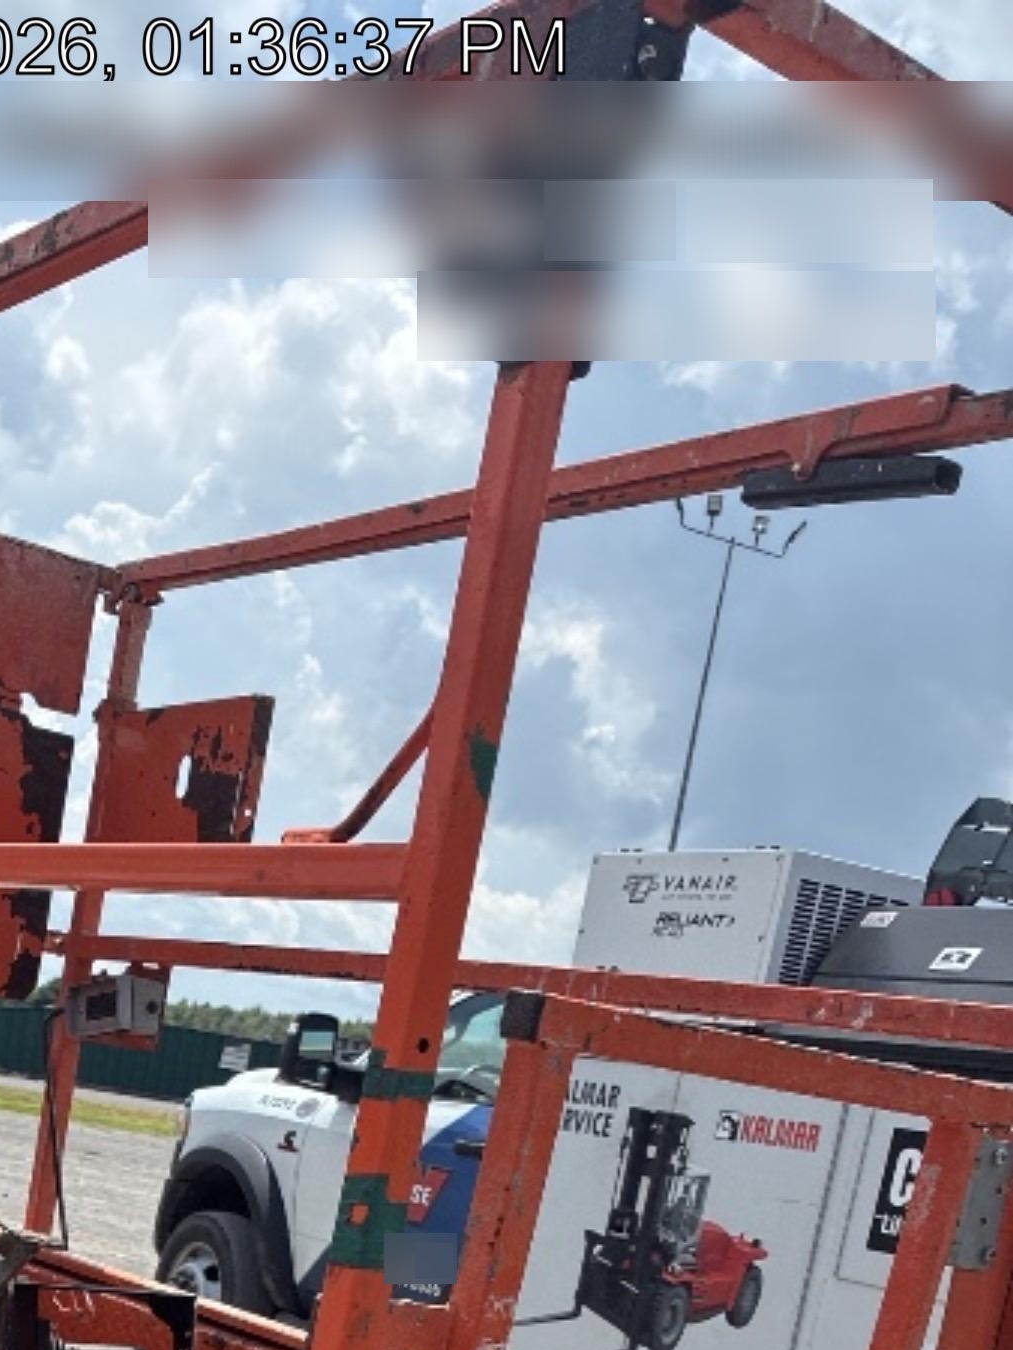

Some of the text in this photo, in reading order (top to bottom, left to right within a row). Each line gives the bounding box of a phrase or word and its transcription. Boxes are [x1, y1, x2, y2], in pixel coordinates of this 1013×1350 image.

[664, 875, 737, 891] VANAIR
[565, 1080, 622, 1110] LMAR
[740, 1115, 822, 1152] KALMAR
